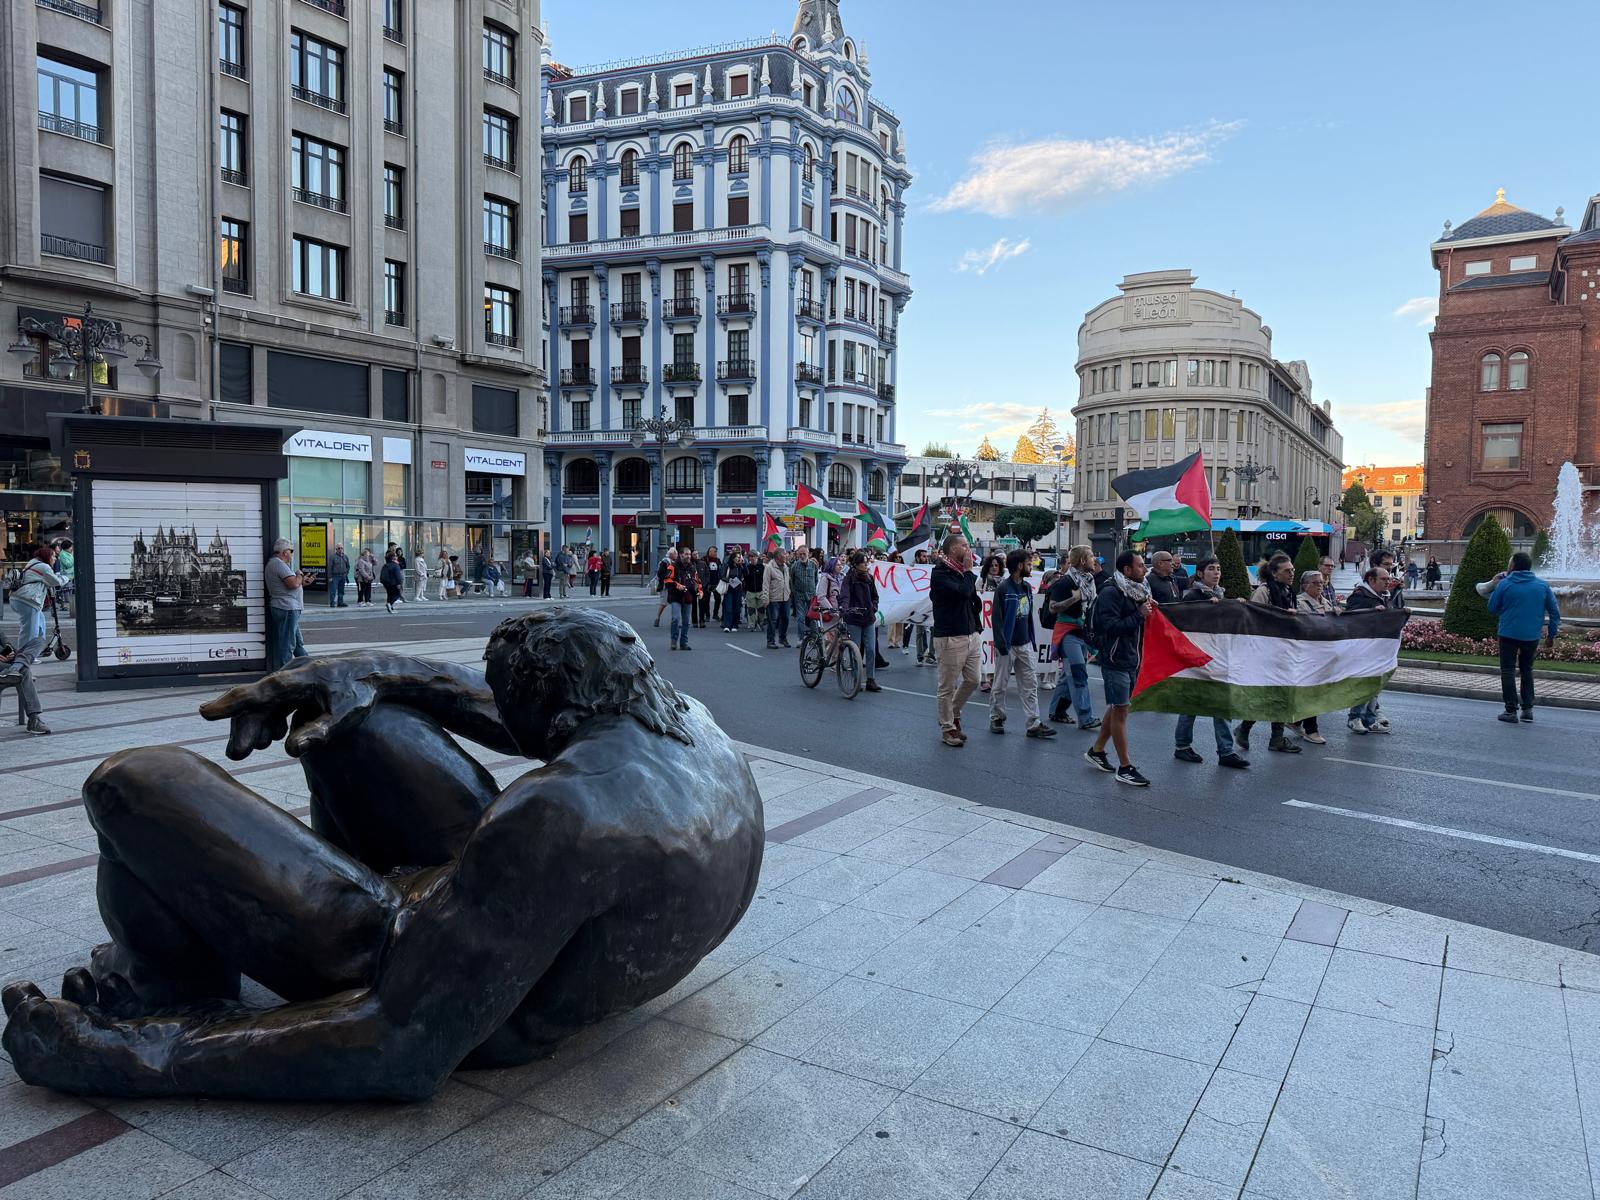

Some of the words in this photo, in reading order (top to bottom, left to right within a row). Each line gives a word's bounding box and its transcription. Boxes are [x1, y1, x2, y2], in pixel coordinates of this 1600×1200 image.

[1134, 294, 1177, 307] museo
[1142, 304, 1177, 319] León
[294, 437, 369, 453] VITALDENT
[466, 455, 523, 468] VITALDENT
[1092, 510, 1134, 519] MUSO
[1266, 532, 1287, 540] alsa
